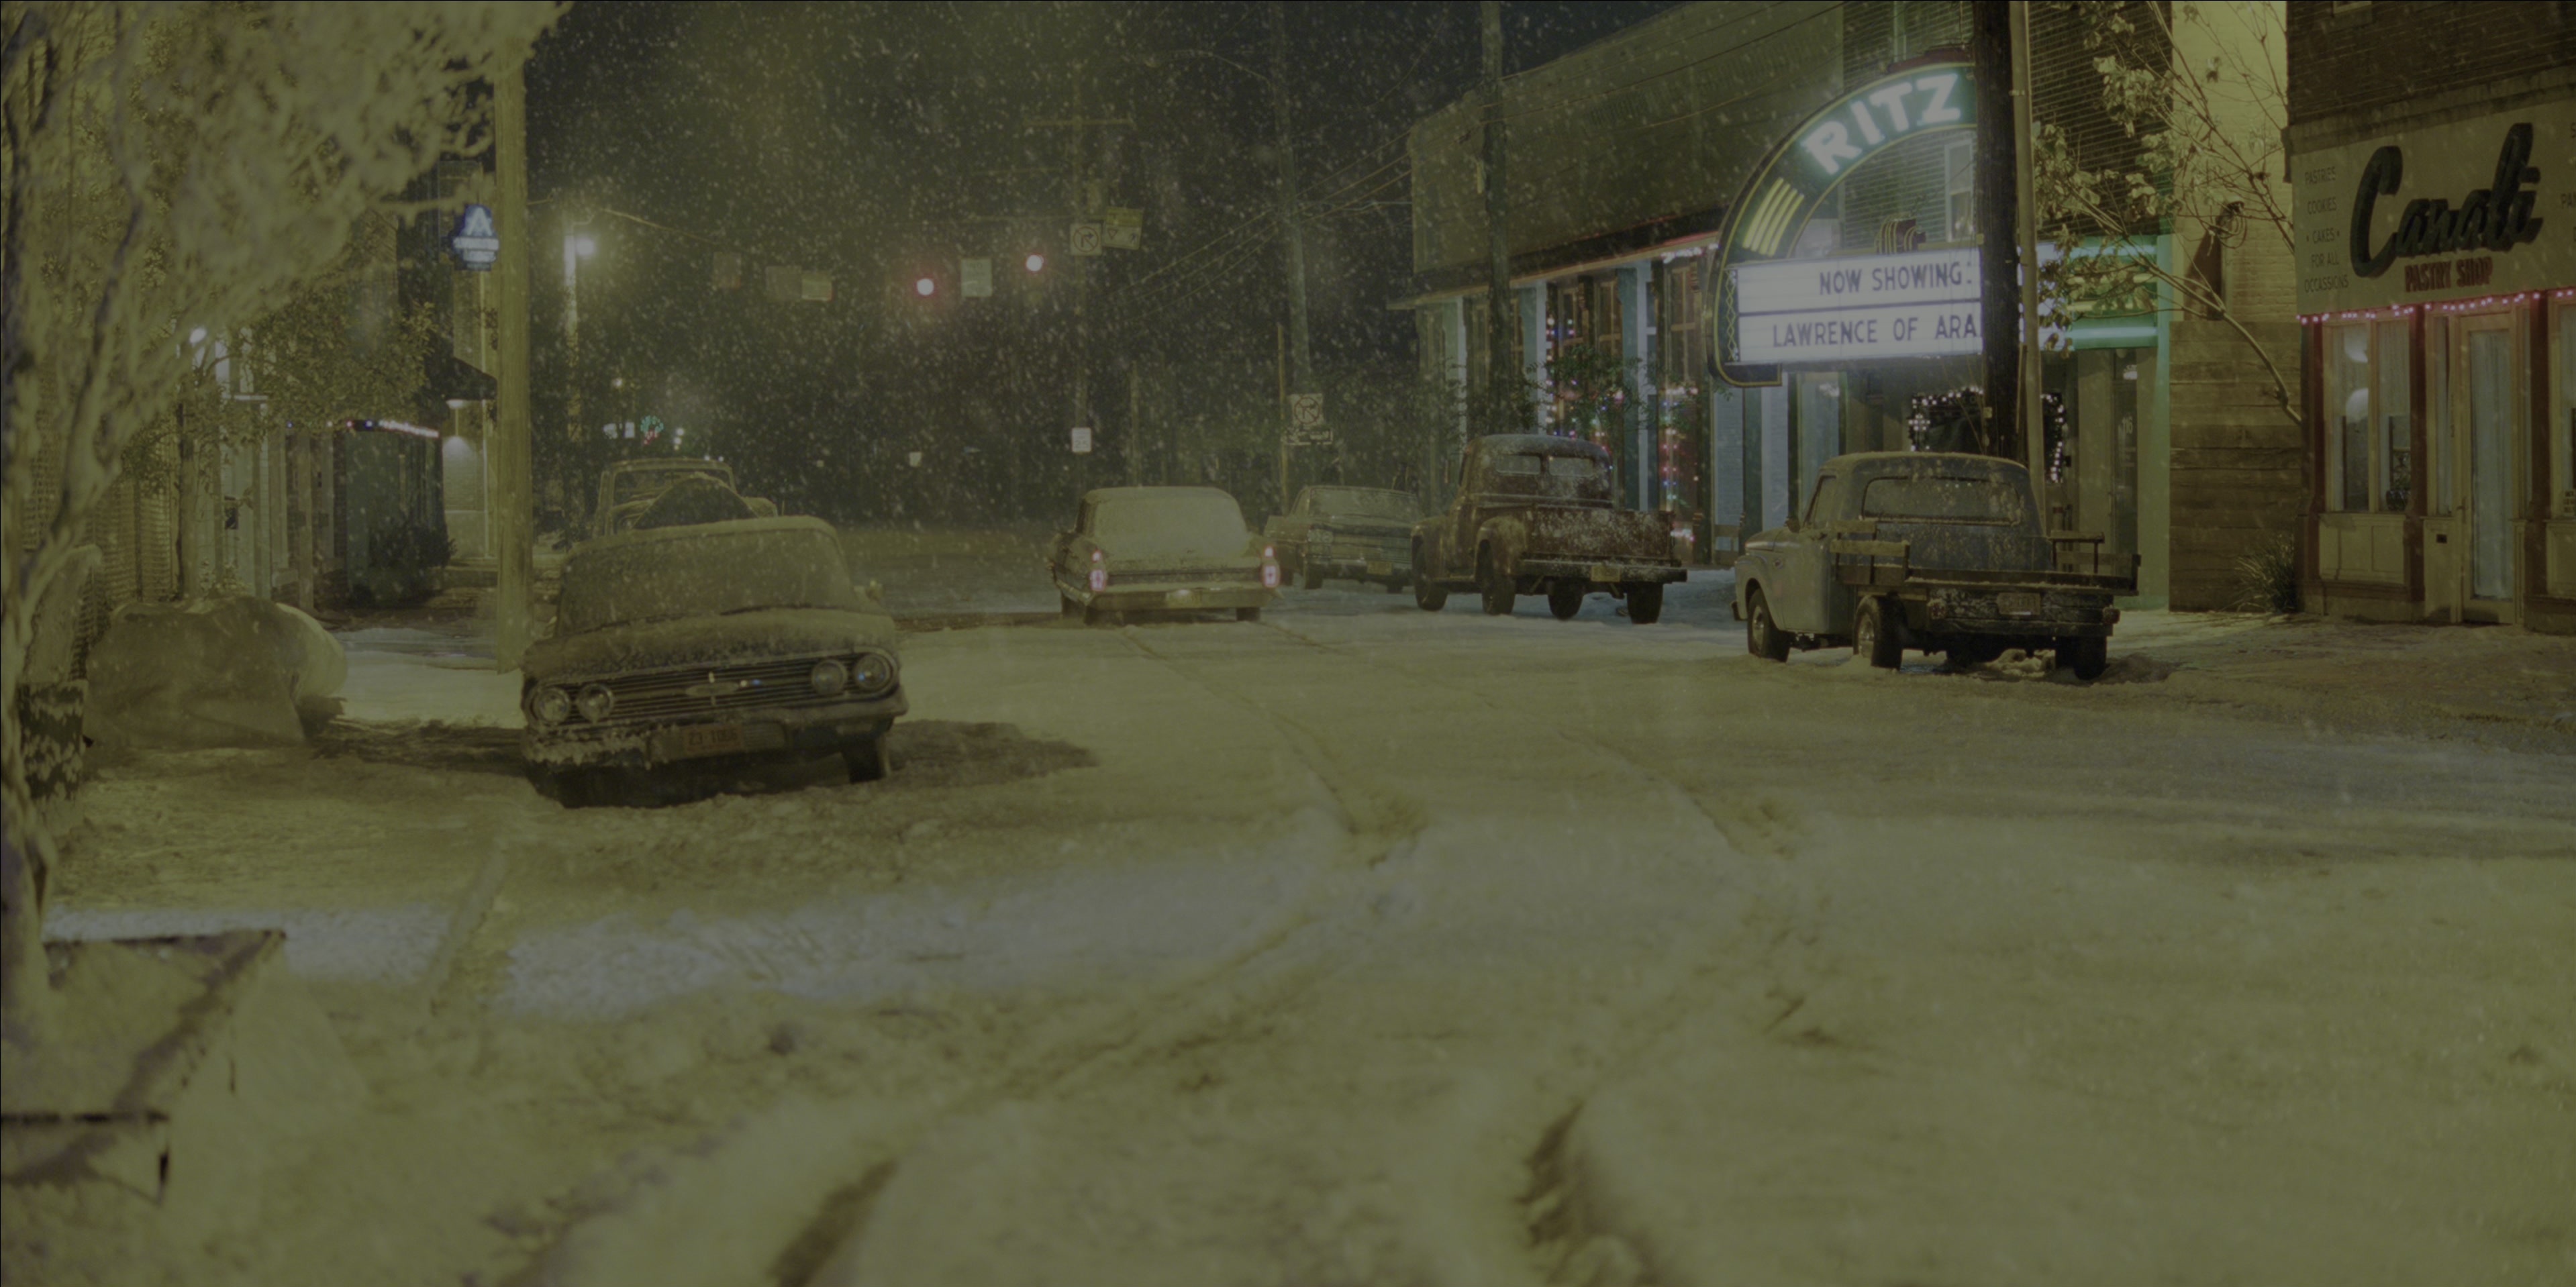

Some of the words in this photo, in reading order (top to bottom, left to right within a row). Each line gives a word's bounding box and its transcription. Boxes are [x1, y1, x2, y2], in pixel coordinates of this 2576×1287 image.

[1800, 72, 1961, 175] RITZ
[2304, 166, 2336, 185] PASTRIES
[2308, 197, 2337, 214] COOKIES
[2312, 227, 2335, 244] CAKES
[2311, 253, 2325, 268] FOR
[2327, 251, 2340, 266] ALL
[1820, 269, 1863, 295] NOW
[1872, 260, 1973, 292] SHOWING:
[2304, 274, 2348, 293] OCCASSIONS
[2405, 260, 2452, 293] PASTRY
[2457, 256, 2493, 288] SHOP
[1773, 319, 1879, 348] LAWRENCE
[1892, 317, 1919, 342] OF
[1934, 313, 1982, 340] ARA
[1075, 440, 1089, 449] 25
